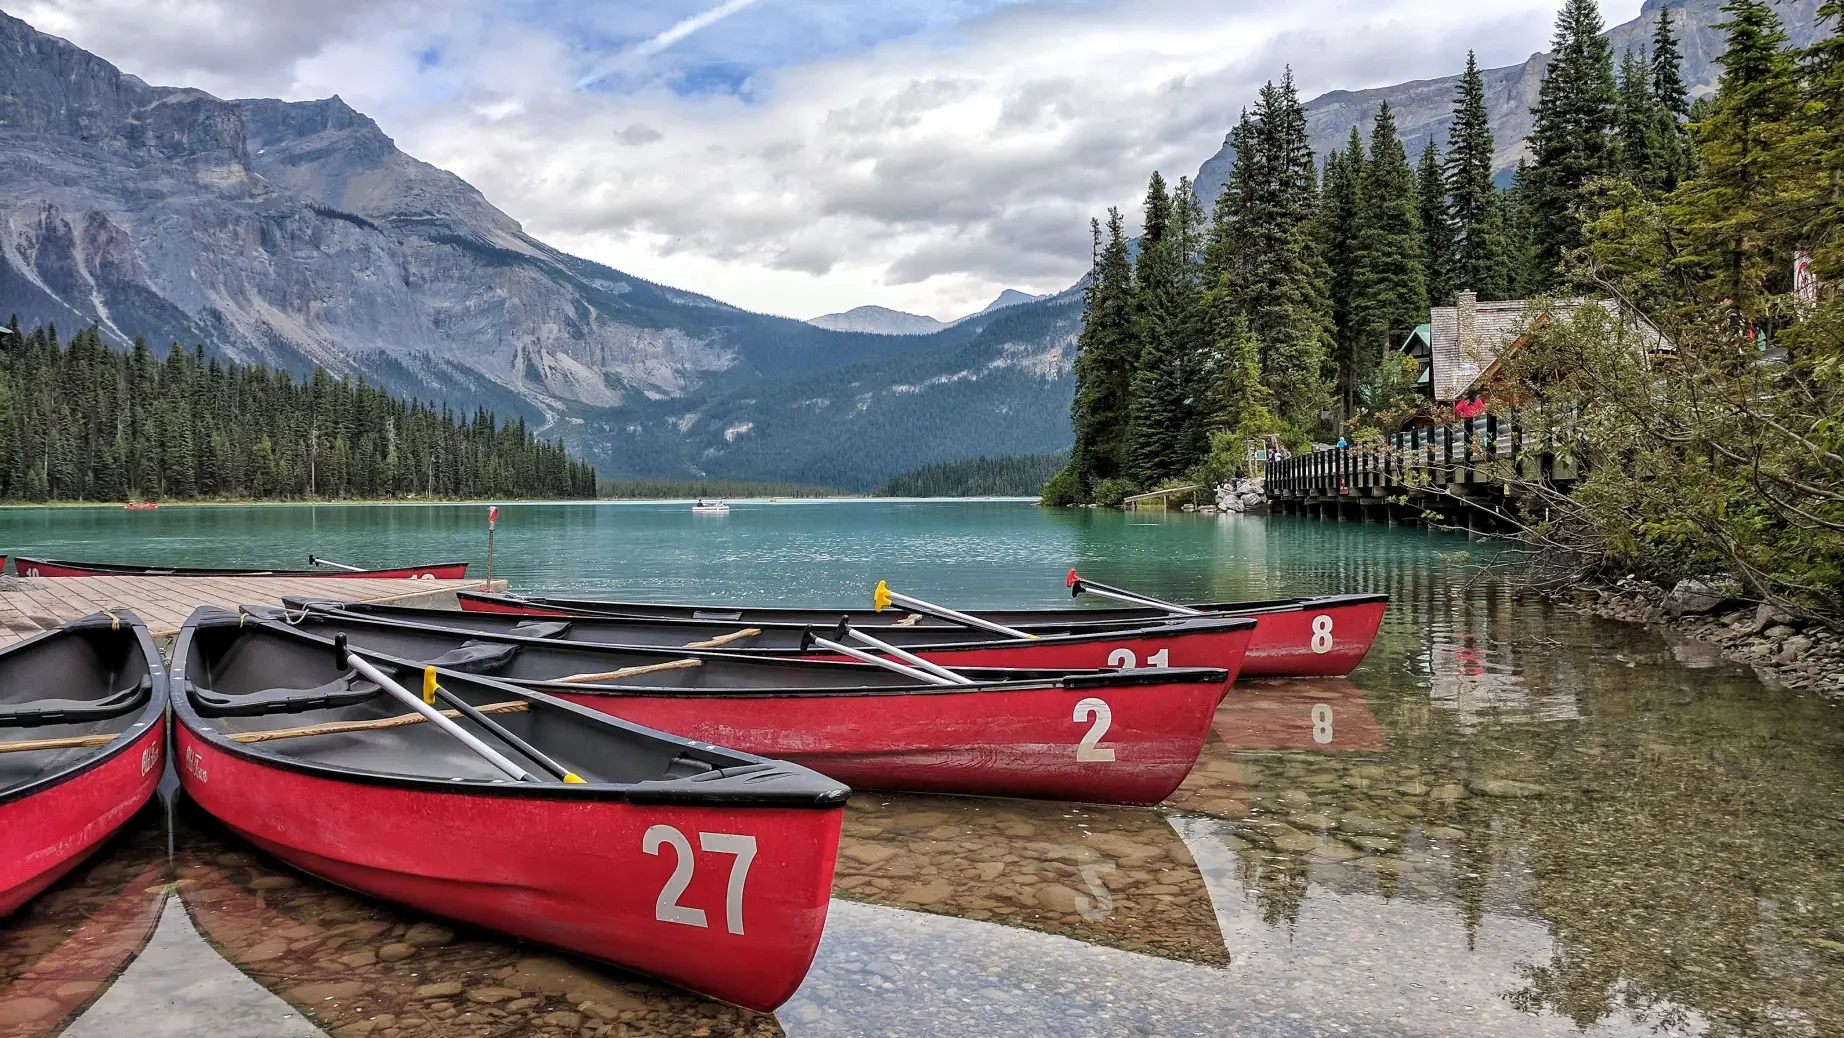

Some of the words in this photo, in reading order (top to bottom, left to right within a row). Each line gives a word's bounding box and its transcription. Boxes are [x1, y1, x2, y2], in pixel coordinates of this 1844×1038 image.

[1311, 614, 1333, 654] 8
[1073, 697, 1116, 762] 2
[642, 824, 758, 936] 27
